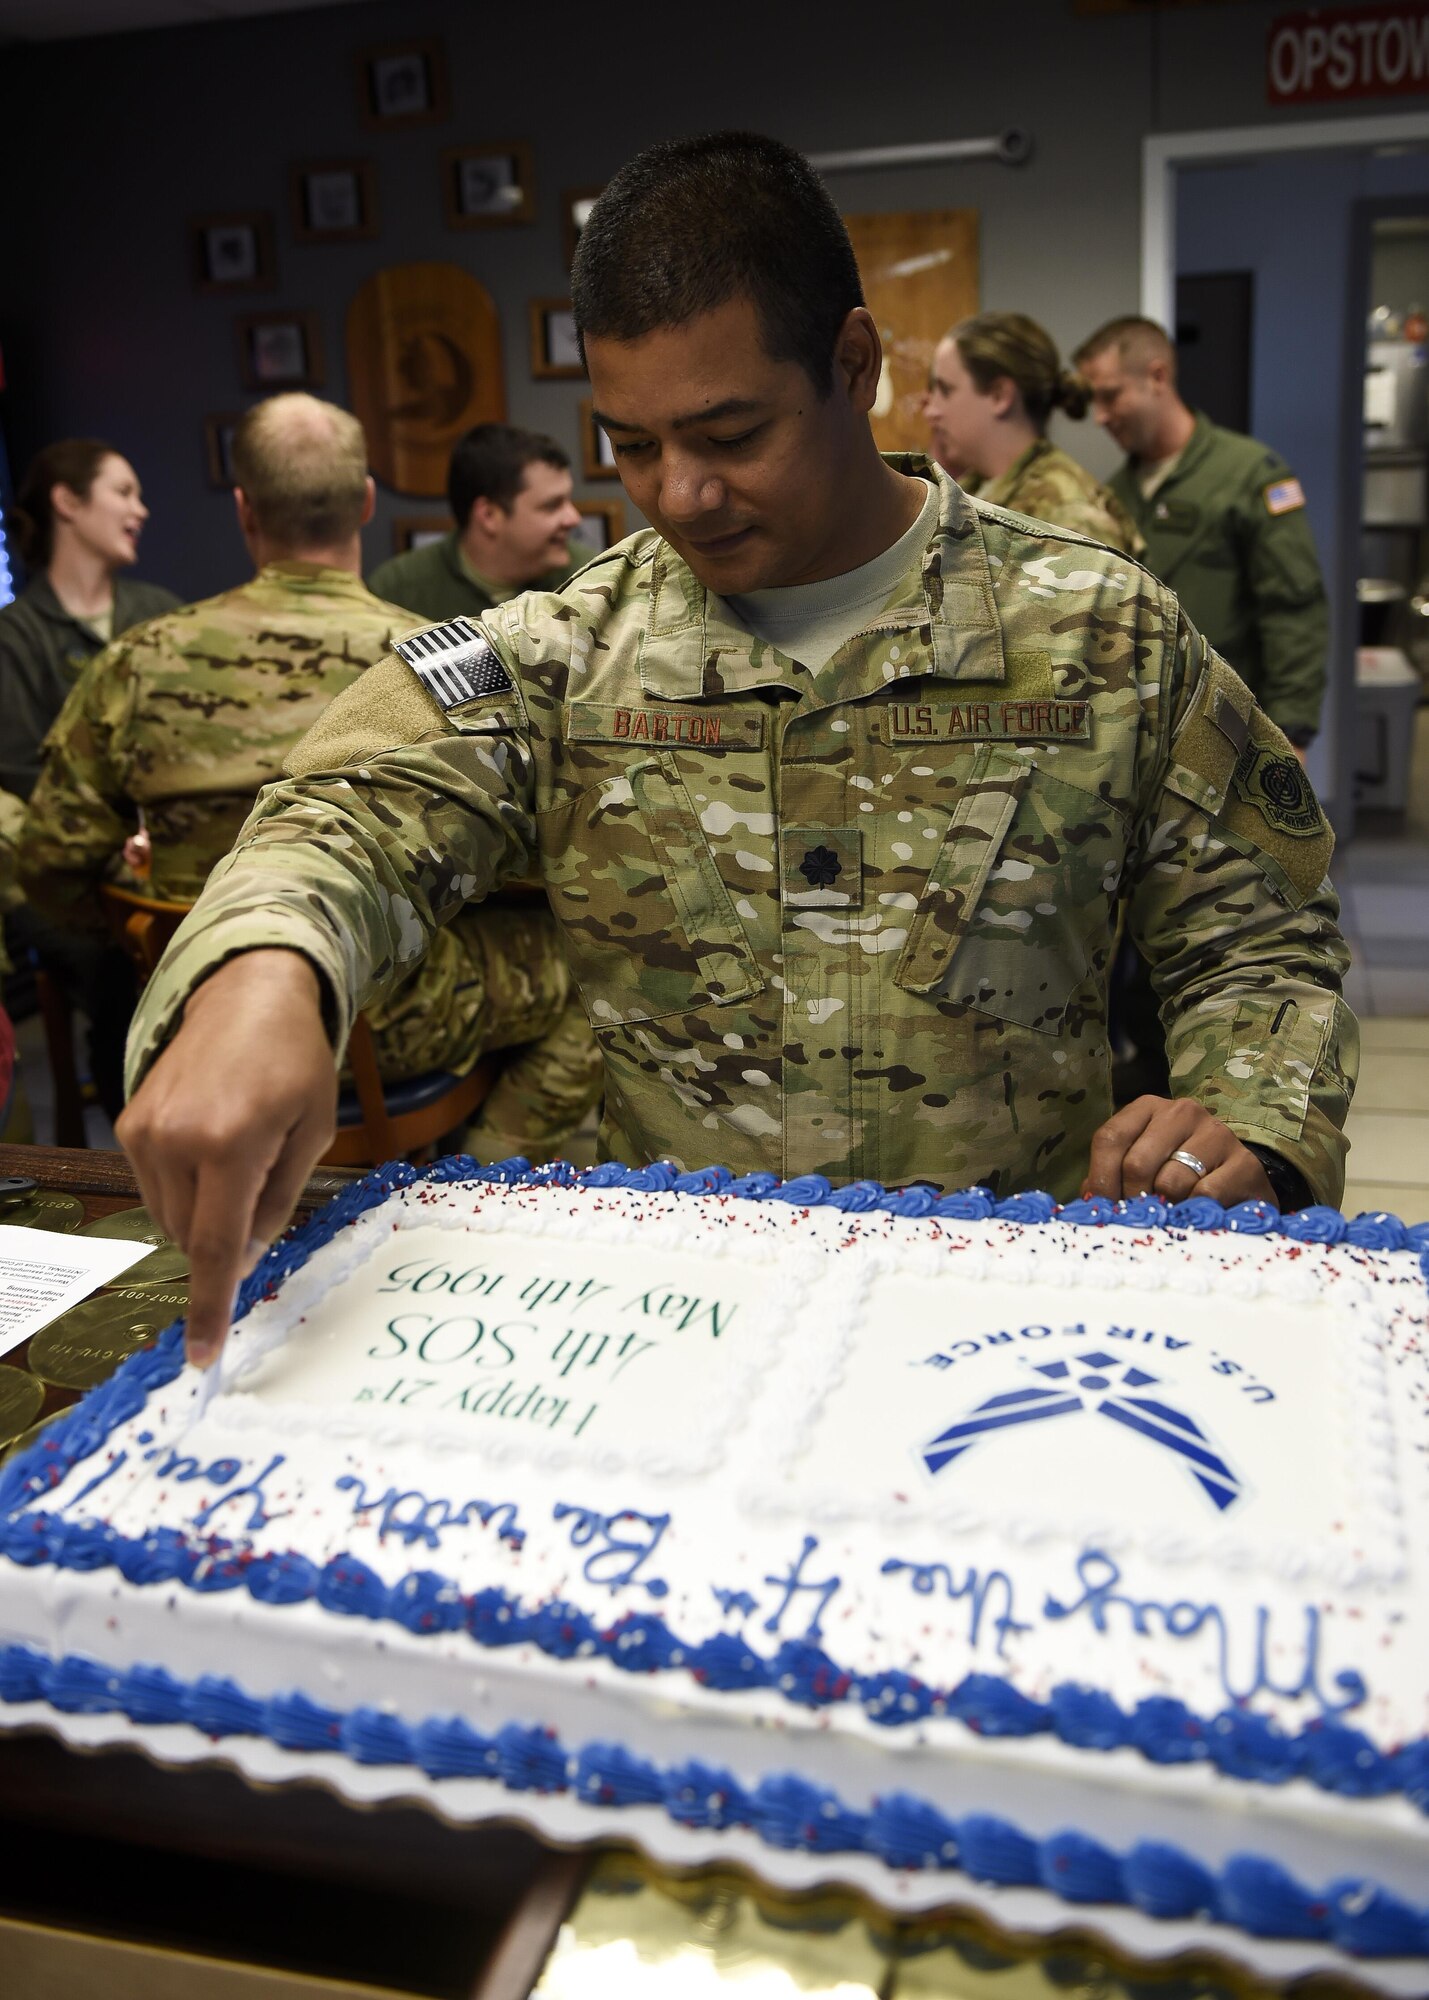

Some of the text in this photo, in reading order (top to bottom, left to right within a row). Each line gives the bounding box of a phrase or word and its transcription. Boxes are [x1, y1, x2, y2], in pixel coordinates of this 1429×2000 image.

[613, 709, 722, 744] BARTON
[892, 703, 1087, 736] U.S. AIR FORCE
[7, 1285, 65, 1298] tough training
[48, 1266, 83, 1274] INTERNAL
[376, 1259, 740, 1338] May 4th 1995
[368, 1313, 659, 1383] 4th SOS
[923, 1323, 1277, 1404] U.S. AIR FORCE
[442, 1376, 598, 1438] Happy
[336, 1475, 527, 1549] with
[553, 1501, 671, 1598] Be
[881, 1558, 1033, 1658] the
[1043, 1546, 1368, 1713] May
